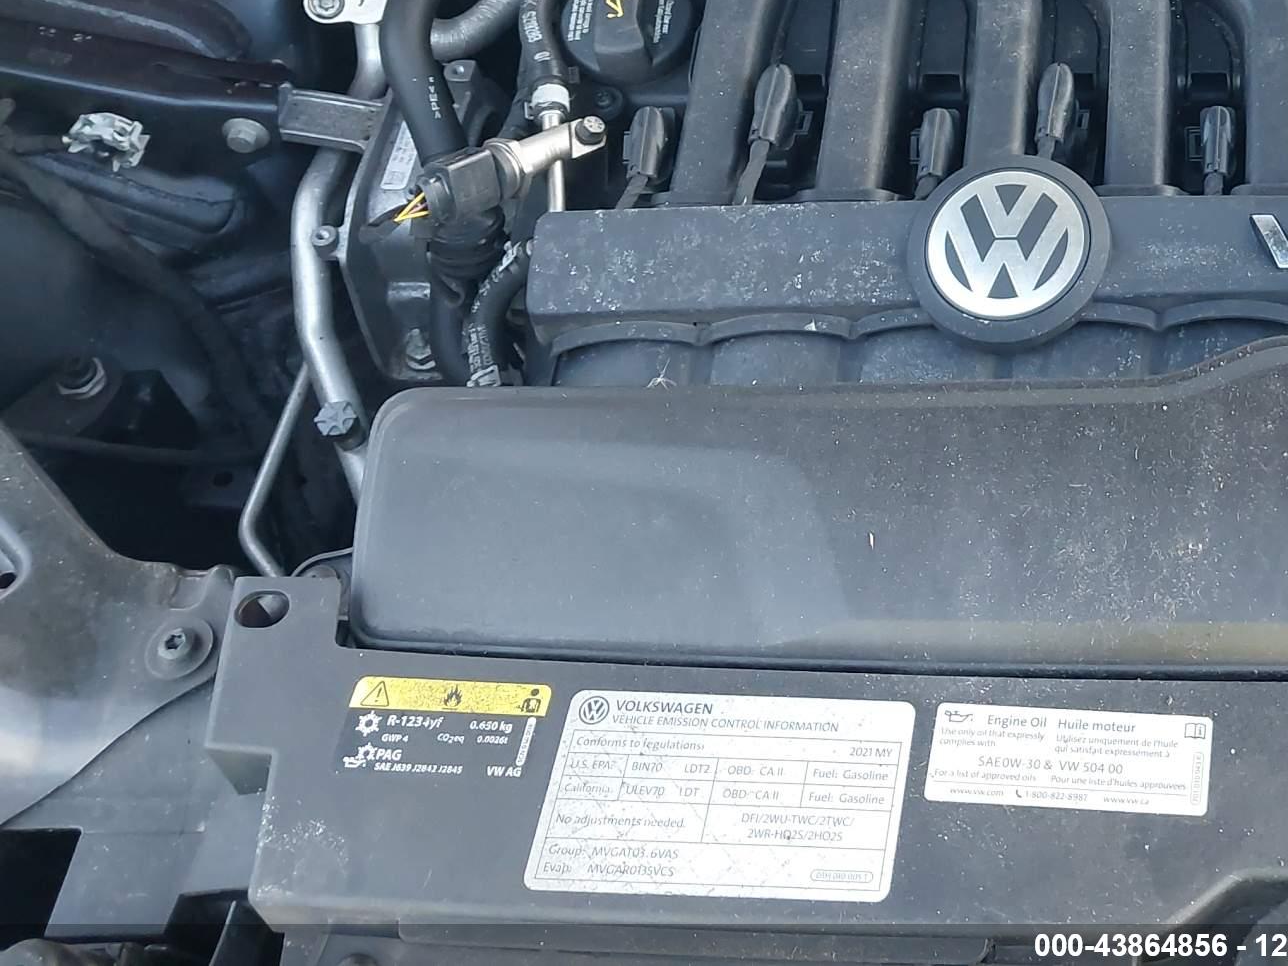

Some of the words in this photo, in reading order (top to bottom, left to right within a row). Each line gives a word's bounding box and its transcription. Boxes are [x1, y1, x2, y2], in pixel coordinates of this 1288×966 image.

[616, 699, 713, 715] VOLKSWAGEN
[387, 714, 445, 730] R-1234yf
[469, 720, 499, 731] 0.650
[499, 720, 513, 734] kg
[612, 714, 654, 725] VEHICLE
[656, 715, 708, 727] EMISSION
[711, 718, 761, 729] CONTROL
[763, 720, 839, 732] INFORMATION
[987, 714, 1028, 729] Engine
[1030, 716, 1047, 727] Oil
[1058, 719, 1089, 730] Huile
[1092, 721, 1136, 733] moteur
[1007, 731, 1045, 742] expressly
[375, 747, 402, 762] PAG
[576, 736, 626, 747] Conforms
[630, 737, 641, 748] to
[849, 746, 873, 757] 2021
[874, 747, 893, 758] MY
[373, 762, 392, 772] SAE
[487, 765, 506, 777] VW
[505, 766, 522, 778] AG
[631, 761, 663, 772] BIN70
[684, 763, 711, 774] LDT2
[759, 766, 775, 777] CA
[812, 767, 838, 779] Fuel:
[842, 769, 889, 782] Gasoline
[1043, 759, 1053, 770] &
[1058, 759, 1080, 772] VW
[1083, 761, 1105, 774] 504
[1107, 763, 1124, 775] 00
[1050, 775, 1070, 785] Pour
[625, 785, 665, 797] ULEV70
[755, 789, 771, 800] CA
[808, 791, 833, 802] Fuel:
[839, 792, 885, 805] Gasoline
[555, 813, 572, 824] No
[574, 814, 642, 827] adjustments
